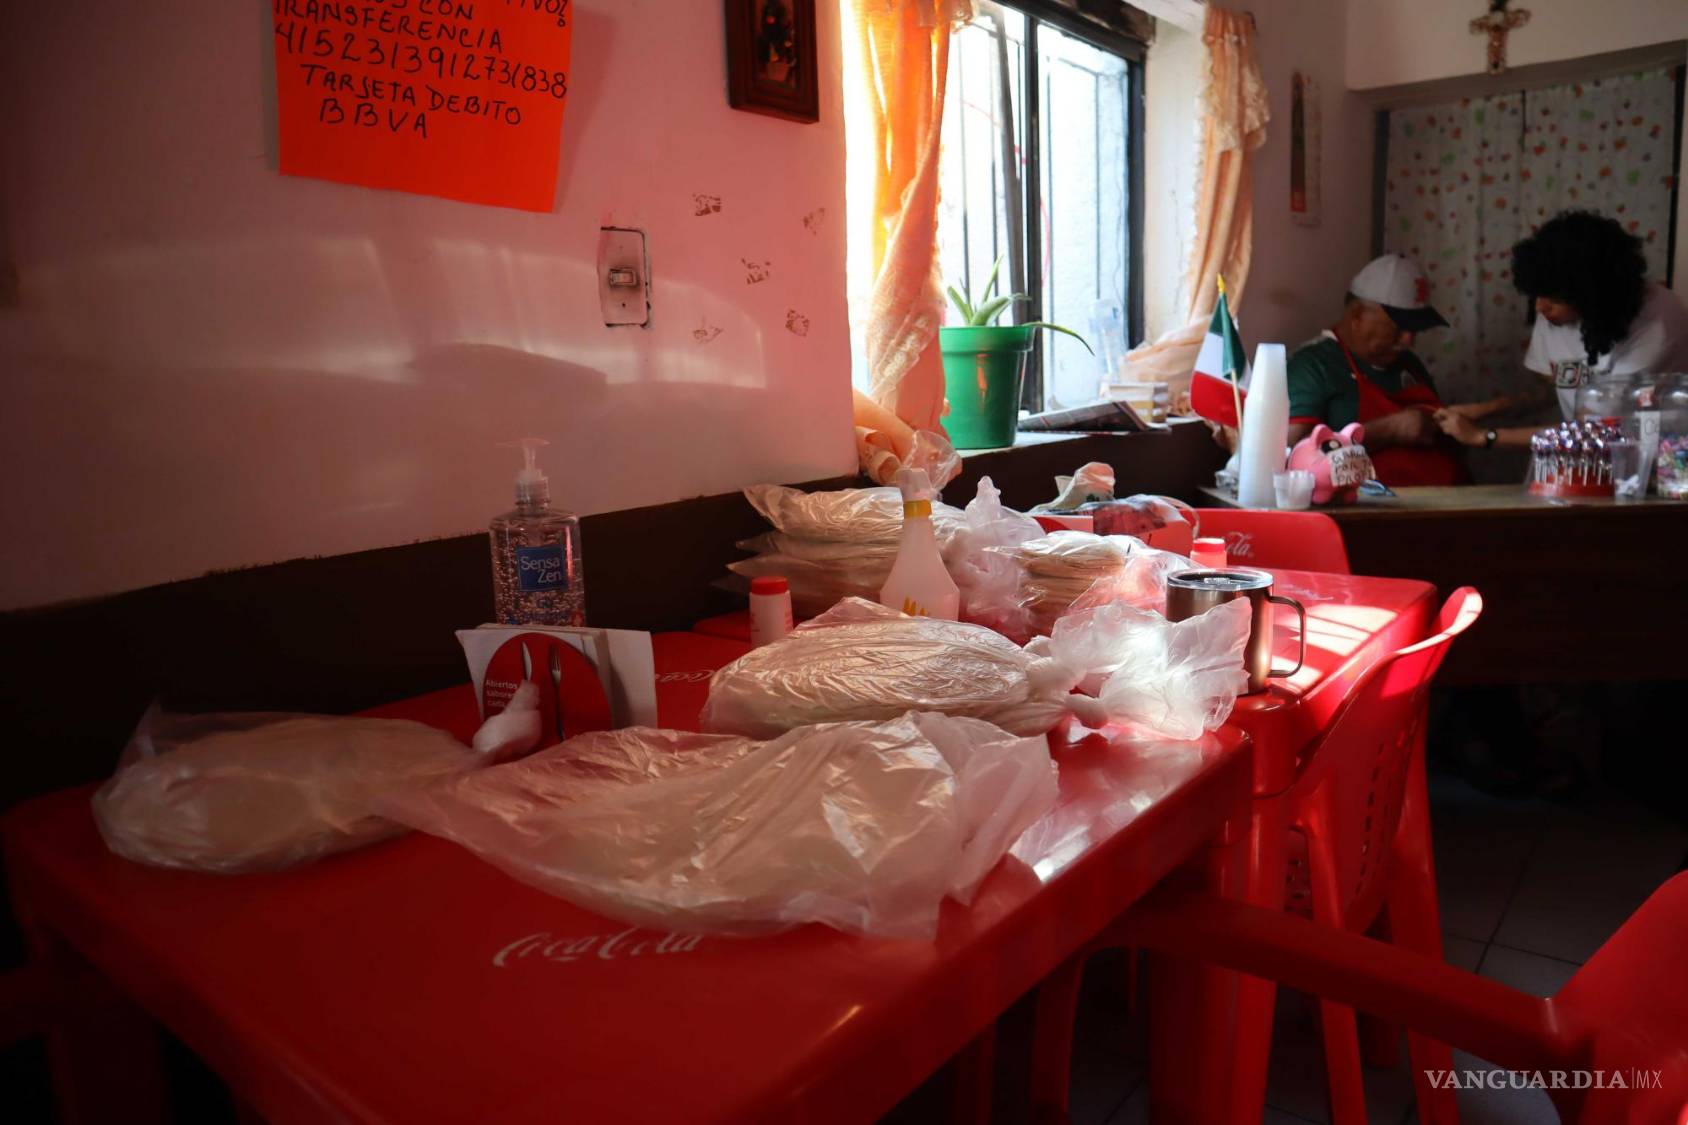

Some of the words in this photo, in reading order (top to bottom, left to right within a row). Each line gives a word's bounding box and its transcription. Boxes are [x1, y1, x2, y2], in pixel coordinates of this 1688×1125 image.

[419, 0, 473, 20] CON
[275, 0, 502, 53] TRANSFERENCIA
[425, 84, 521, 125] DEBITO
[319, 98, 427, 139] BBVA
[1226, 530, 1253, 557] ola
[520, 556, 560, 571] Sensa
[537, 569, 561, 584] Zen
